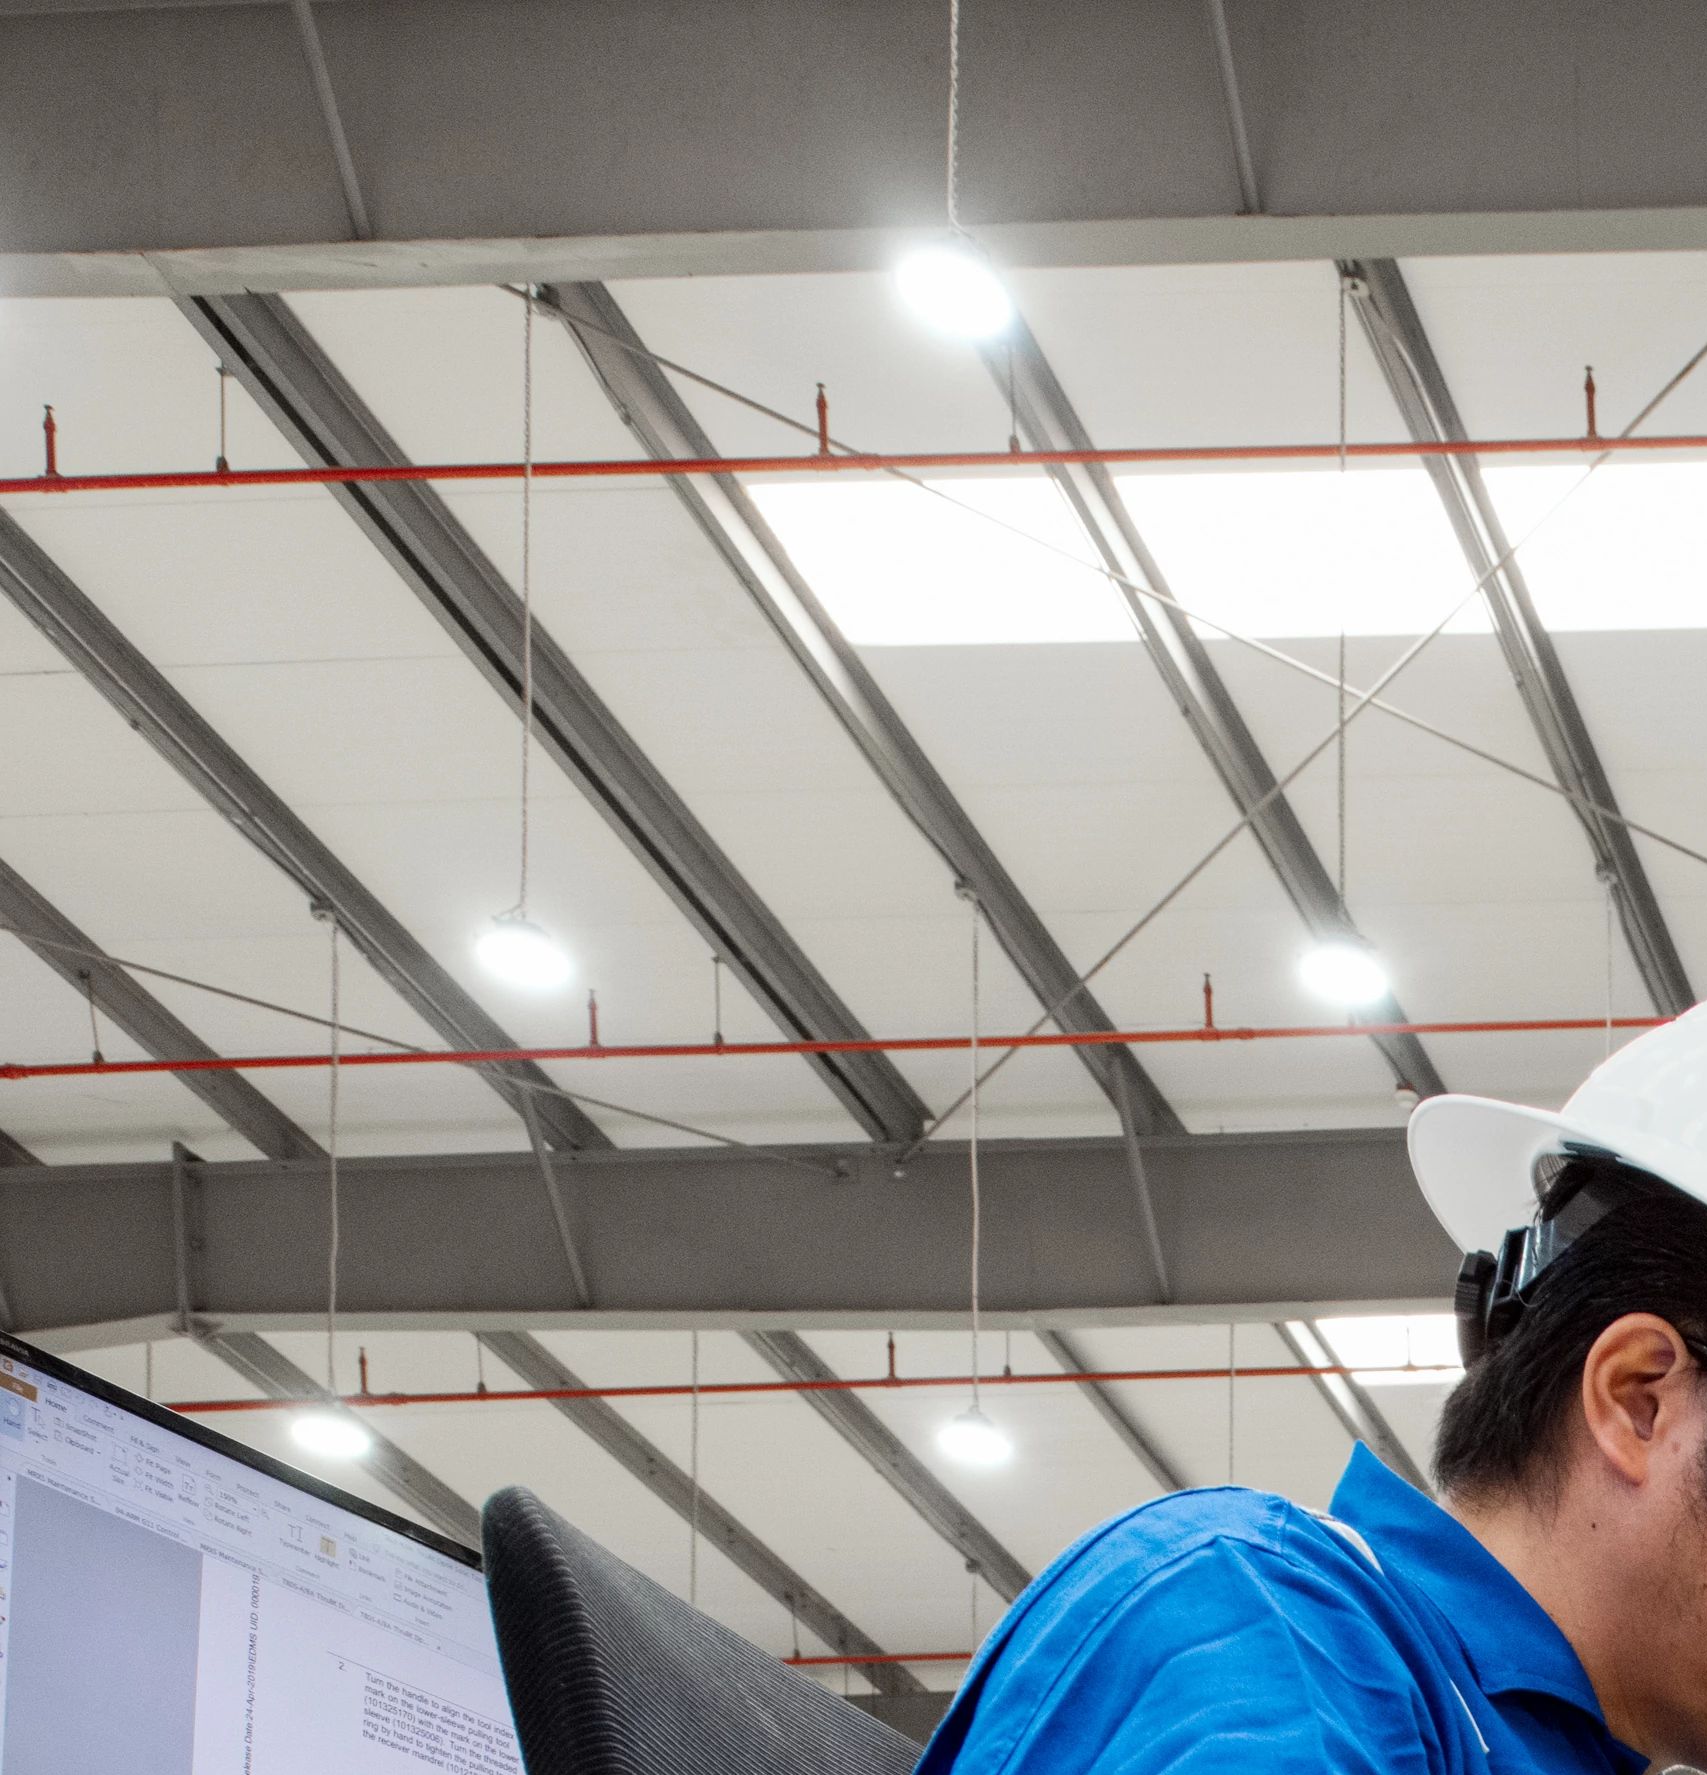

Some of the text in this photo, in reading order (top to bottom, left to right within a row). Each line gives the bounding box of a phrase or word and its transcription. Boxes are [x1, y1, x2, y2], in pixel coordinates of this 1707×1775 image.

[45, 1397, 67, 1413] Home
[82, 1413, 114, 1434] Comment
[364, 1685, 509, 1749] mark on the lower-sleeve pulling tool
[365, 1671, 513, 1739] Turn the handle to align the tool index
[243, 1720, 252, 1744] Date
[362, 1718, 378, 1732] ring
[380, 1724, 390, 1736] by
[393, 1729, 413, 1744] hand
[415, 1738, 423, 1748] to
[425, 1742, 452, 1759] tighten
[453, 1754, 466, 1765] the
[362, 1729, 375, 1740] the
[377, 1736, 409, 1753] receiver
[411, 1750, 444, 1767] mandrel
[363, 1707, 390, 1723] sleeve
[450, 1739, 467, 1754] Turn
[468, 1748, 481, 1760] the
[483, 1754, 517, 1775] threaded
[417, 1718, 433, 1729] with
[435, 1724, 448, 1735] the
[450, 1731, 469, 1744] mark
[472, 1740, 482, 1749] on
[484, 1743, 496, 1754] the
[498, 1749, 518, 1763] lower
